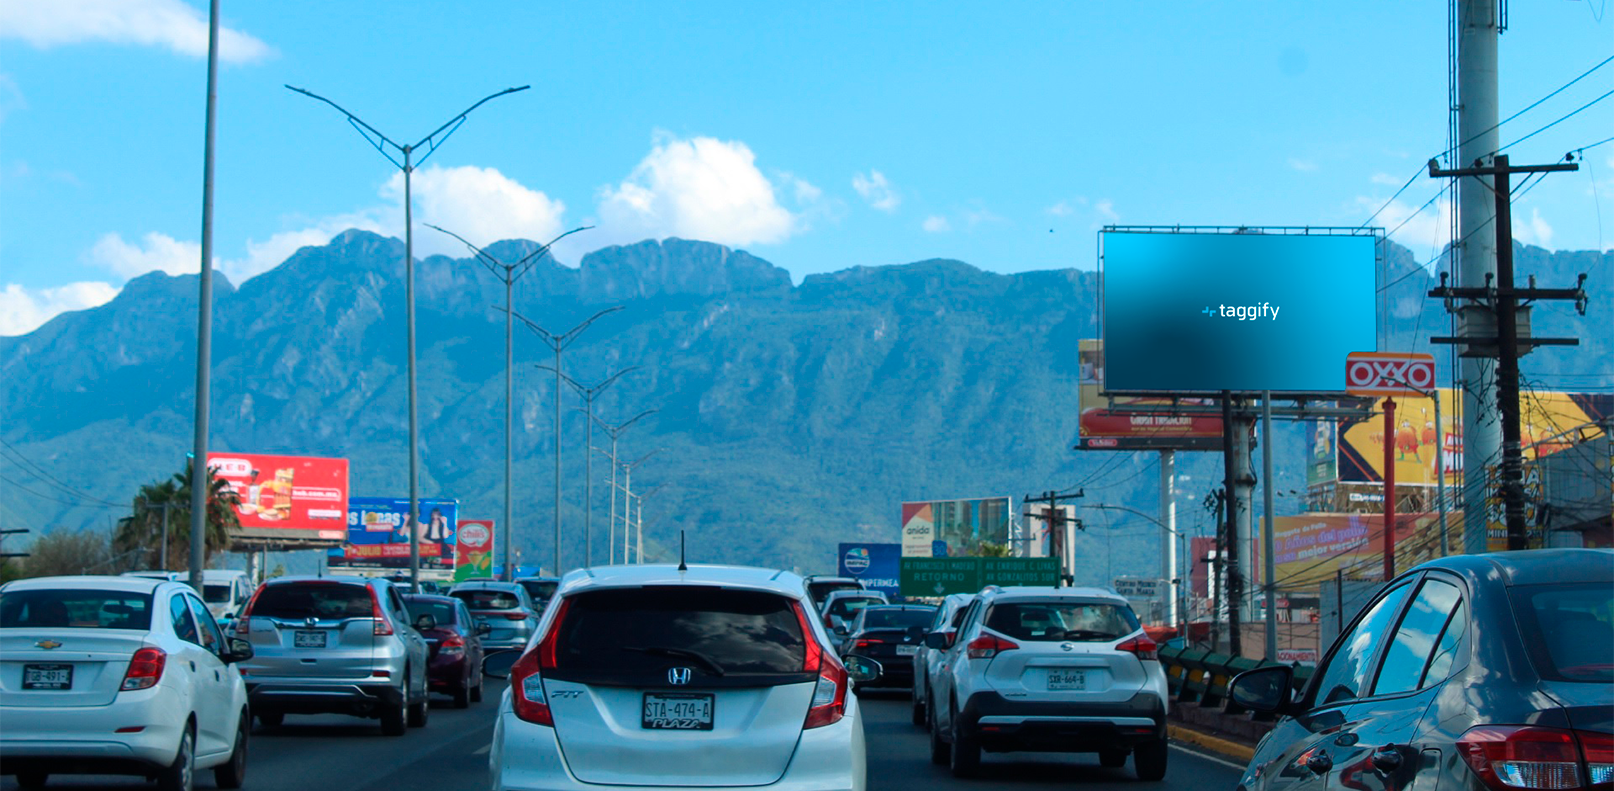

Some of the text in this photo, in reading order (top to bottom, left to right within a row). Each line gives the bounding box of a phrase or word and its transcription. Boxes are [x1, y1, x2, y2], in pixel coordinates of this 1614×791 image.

[1219, 302, 1280, 321] taggify
[1350, 361, 1431, 388] OXXO
[1298, 545, 1328, 559] mejor
[1329, 537, 1369, 551] versión
[951, 561, 975, 570] MADERO
[1037, 561, 1056, 570] LIVAS
[914, 572, 965, 581] RETORNO
[997, 572, 1038, 581] GONZALITOS
[1041, 572, 1055, 581] SUR
[551, 690, 584, 698] FIT
[645, 702, 710, 718] STA-474-A
[652, 719, 700, 728] PLAZA
